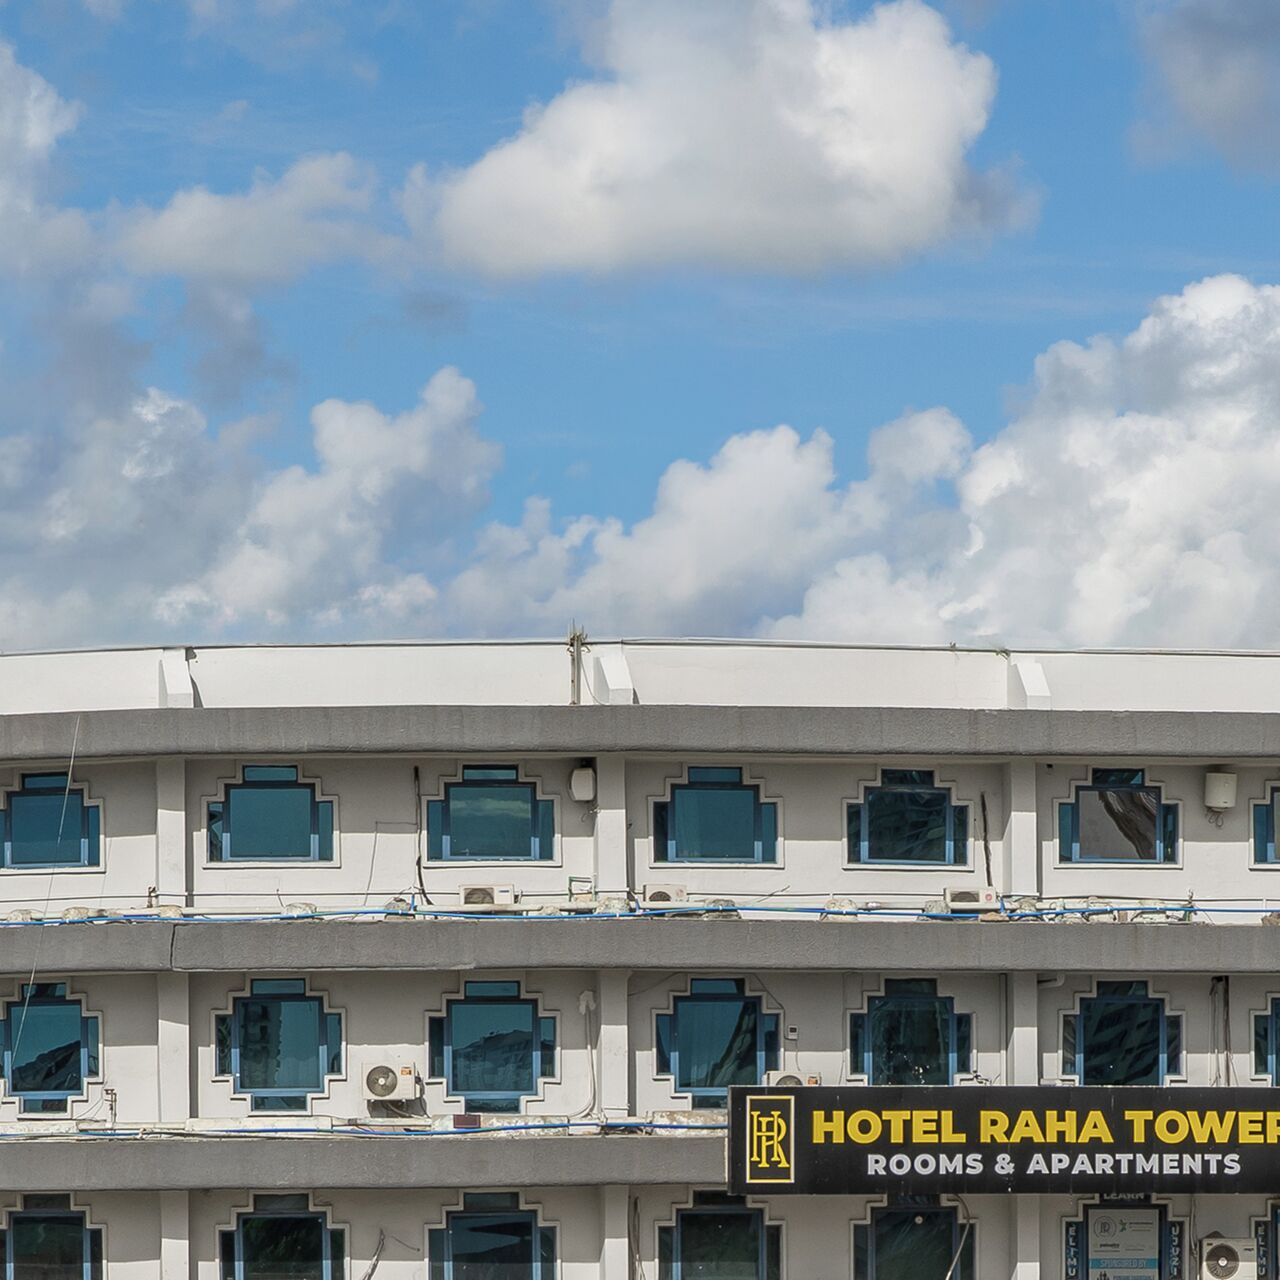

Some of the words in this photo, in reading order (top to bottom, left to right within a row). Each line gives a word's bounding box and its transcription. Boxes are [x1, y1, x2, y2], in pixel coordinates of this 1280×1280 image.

[812, 1110, 967, 1144] HOTEL
[979, 1110, 1114, 1144] RAHA
[868, 1153, 984, 1176] ROOMS
[994, 1153, 1015, 1176] &
[1027, 1153, 1241, 1175] APARTMENTS
